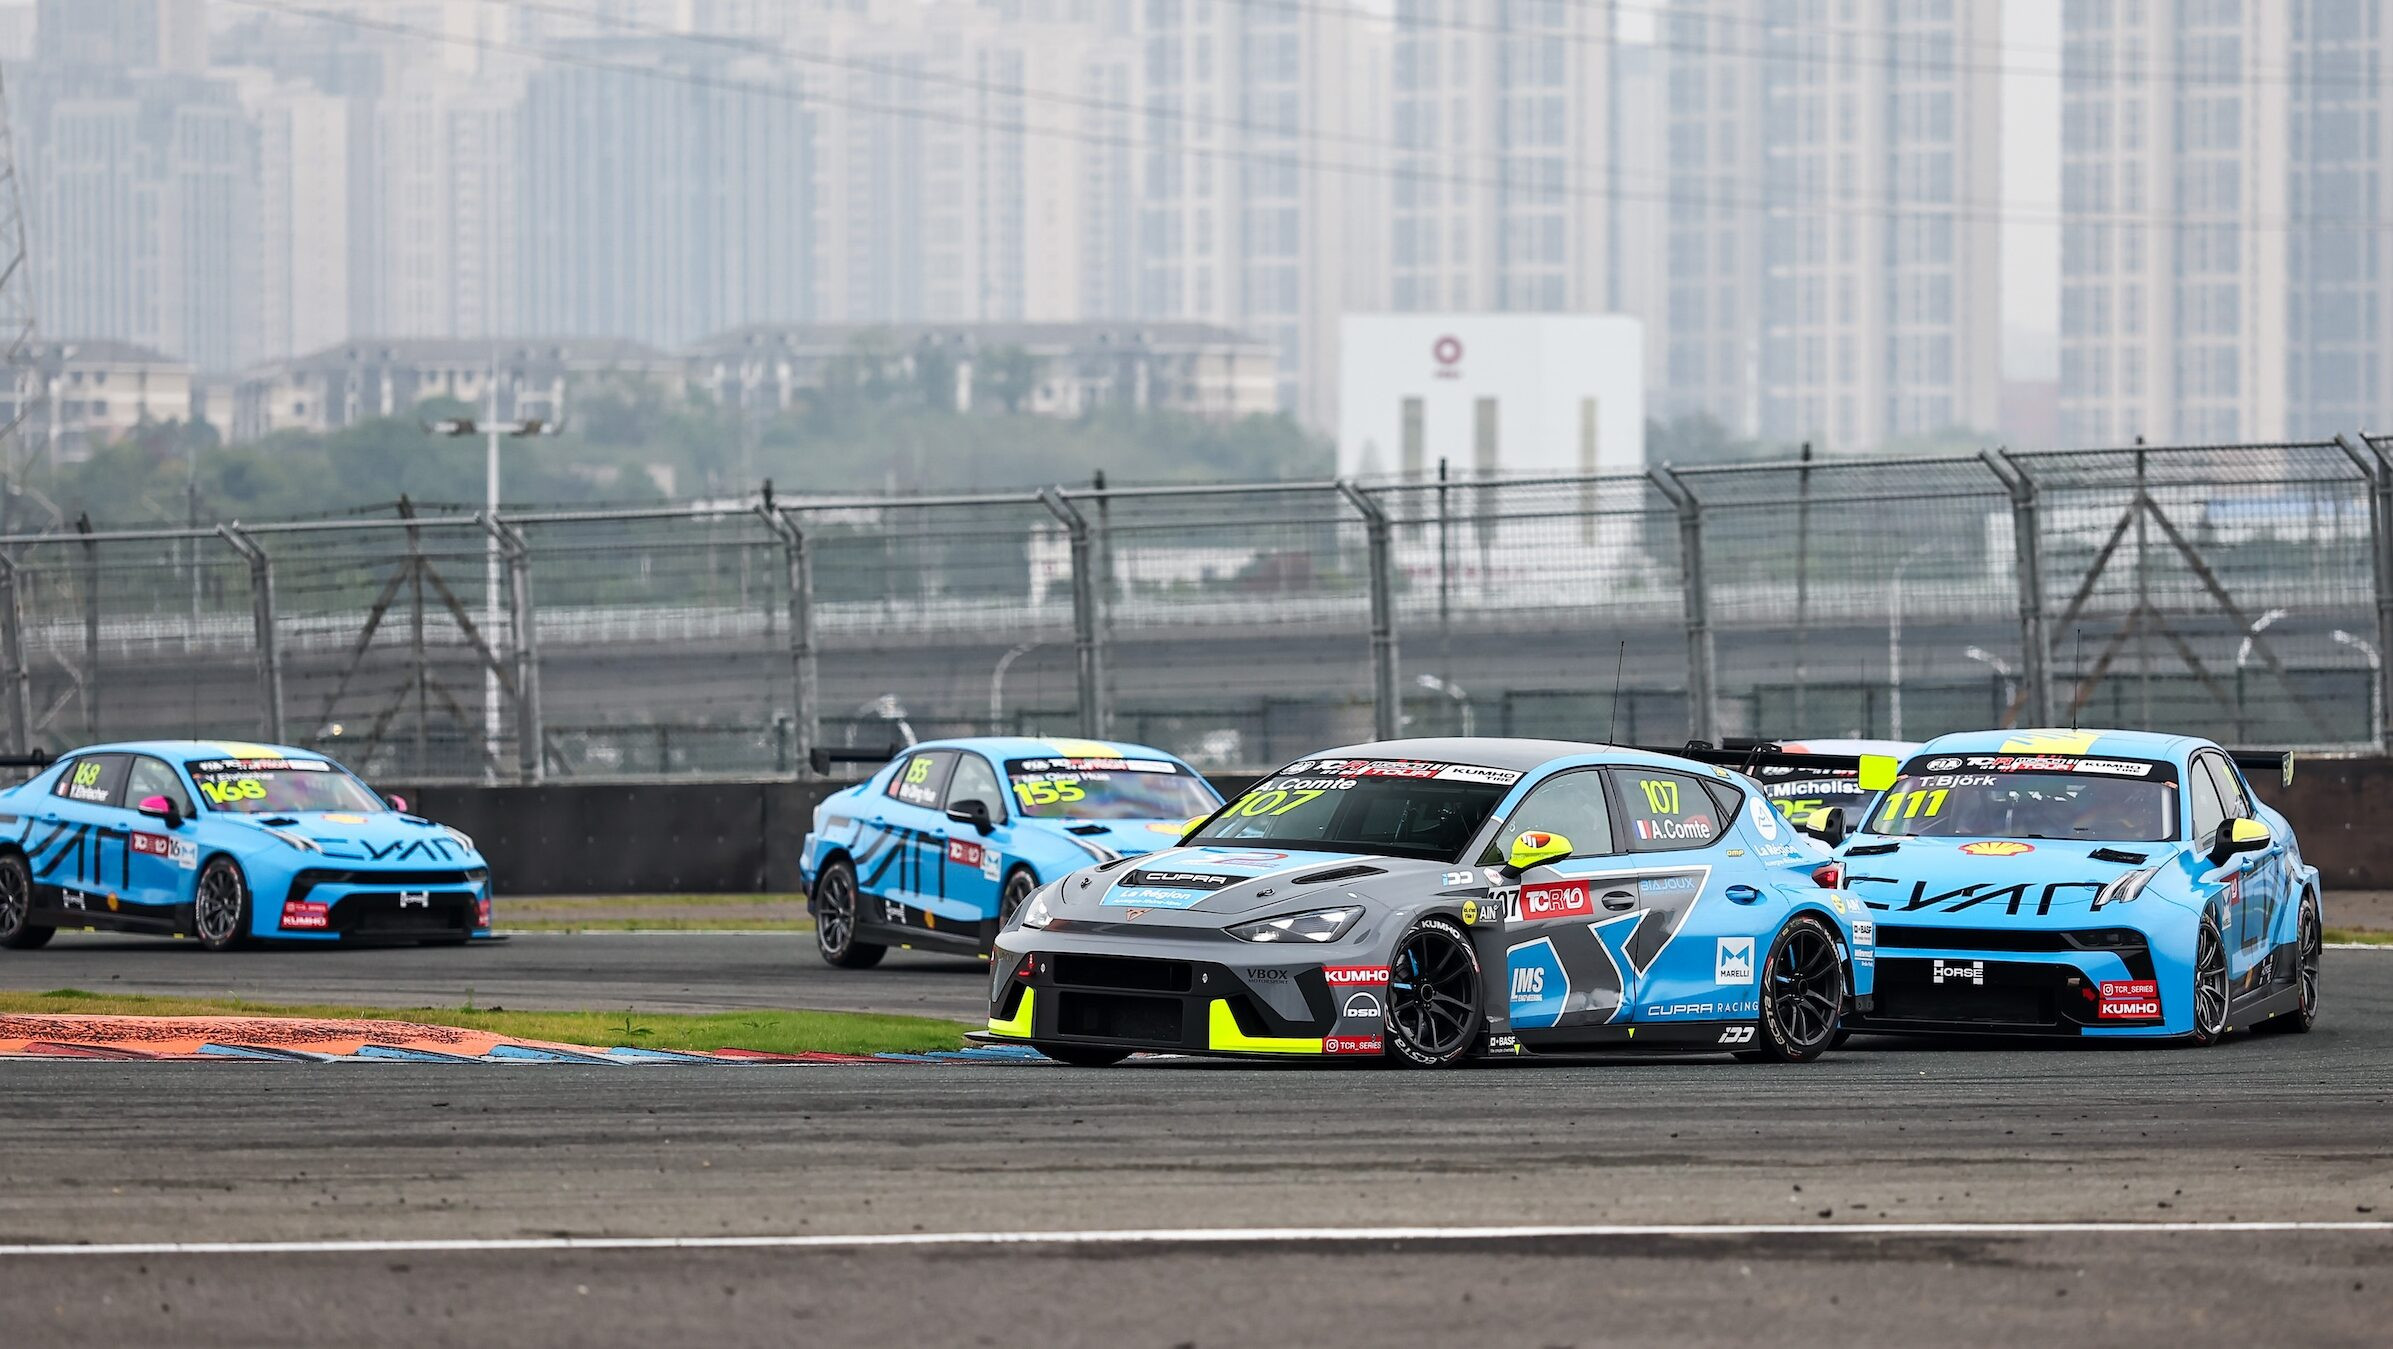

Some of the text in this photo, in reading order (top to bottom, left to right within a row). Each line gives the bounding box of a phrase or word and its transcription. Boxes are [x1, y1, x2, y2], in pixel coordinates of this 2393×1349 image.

[2084, 761, 2141, 770] KUMHO
[73, 761, 101, 785] 168
[1371, 768, 1432, 778] TOUR
[1453, 768, 1516, 778] KUMHO
[1486, 775, 1513, 783] TIRE
[1251, 777, 1358, 793] A.Comte
[1918, 775, 1997, 789] T.Björk
[200, 779, 267, 804] 168
[1013, 779, 1086, 807] 155
[1639, 780, 1679, 815] 107
[1220, 789, 1327, 819] 107
[1882, 788, 1950, 822] 111
[1651, 818, 1711, 840] A.Comte
[1146, 872, 1228, 885] CUPRA
[283, 915, 327, 927] KUMHO
[1421, 919, 1462, 940] KUMHO
[1247, 968, 1288, 980] VBOX
[1325, 970, 1390, 982] KUMHO
[1720, 970, 1750, 978] MARELLI
[1933, 967, 1984, 979] HORSE
[2114, 985, 2154, 995] TCR_SERIES
[1347, 1008, 1378, 1018] DSD
[1647, 1001, 1759, 1016] CUPRA RACING
[2102, 1002, 2158, 1014] KUMHO
[1340, 1041, 1382, 1051] TCR_SERIES
[1499, 1036, 1516, 1046] BASF
